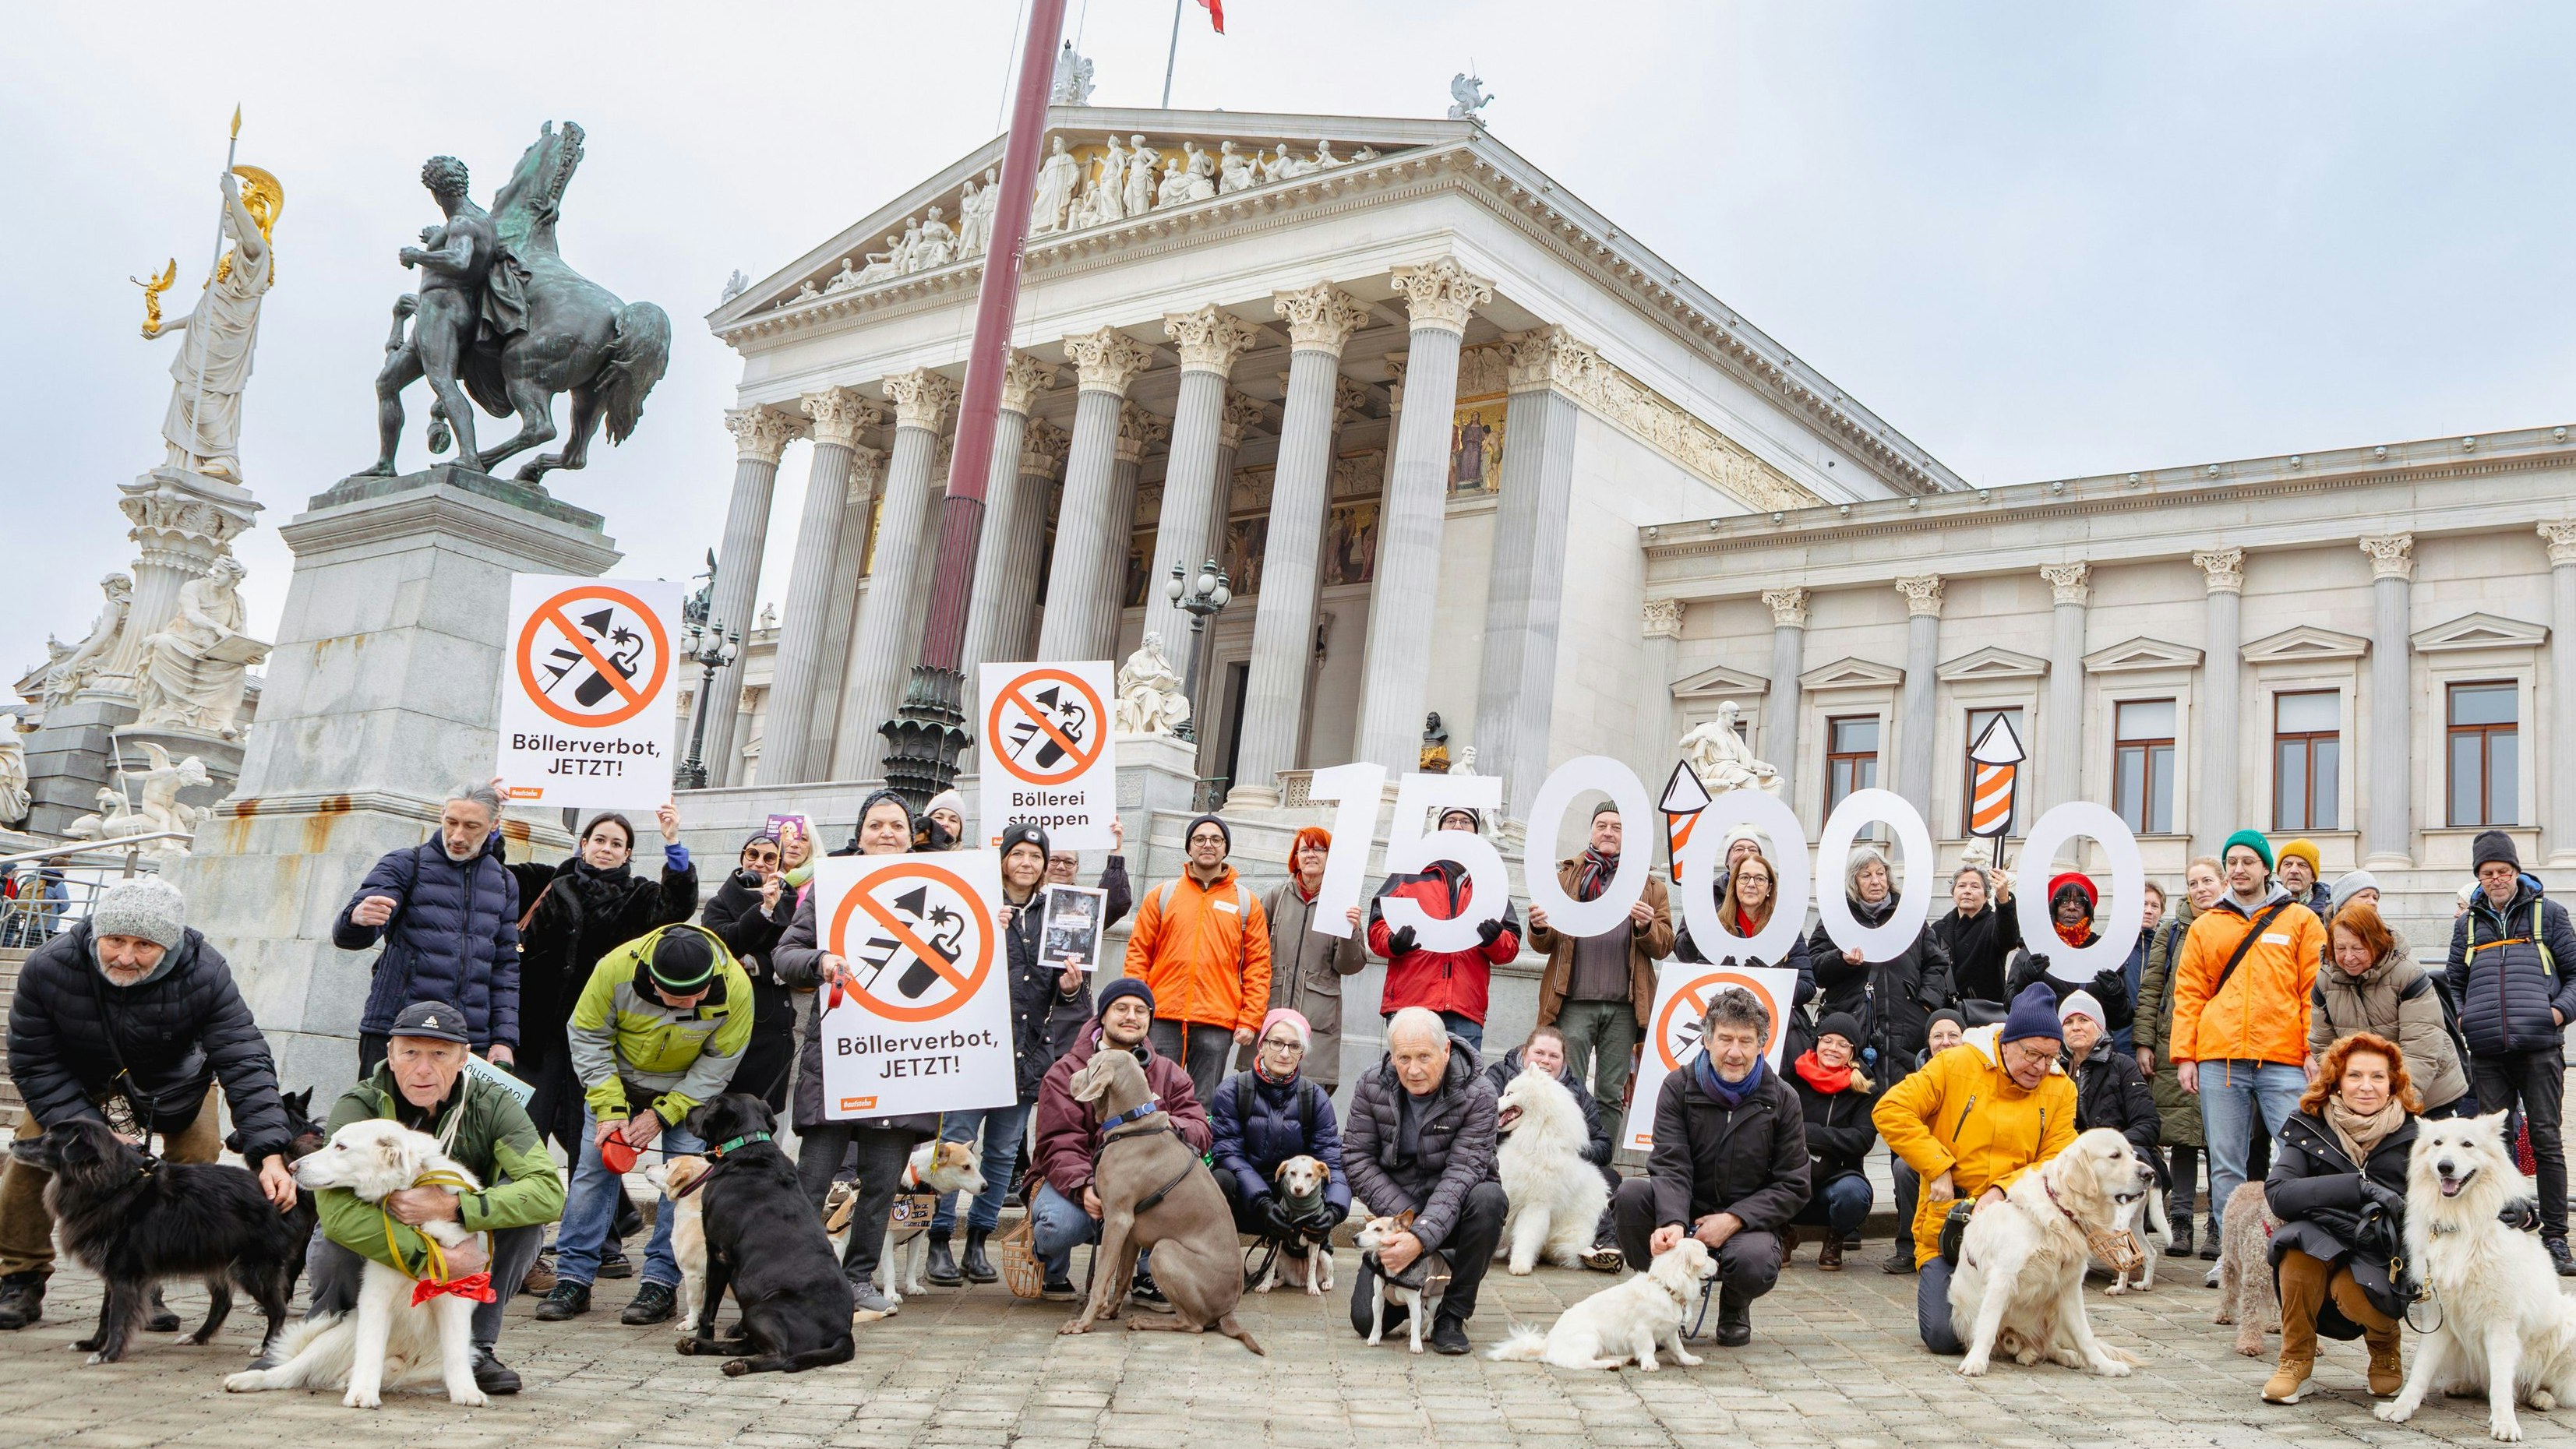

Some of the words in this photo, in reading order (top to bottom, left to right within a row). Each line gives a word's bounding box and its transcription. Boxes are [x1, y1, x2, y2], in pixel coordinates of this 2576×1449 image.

[513, 733, 660, 758] Böllerverbot,
[548, 758, 623, 777] JETZT!
[1013, 791, 1085, 806] Böllerei
[1008, 813, 1089, 830] stoppen
[837, 1029, 998, 1056] Böllerverbot,
[464, 1063, 493, 1082] ÖLLER
[879, 1056, 960, 1078] JETZT!
